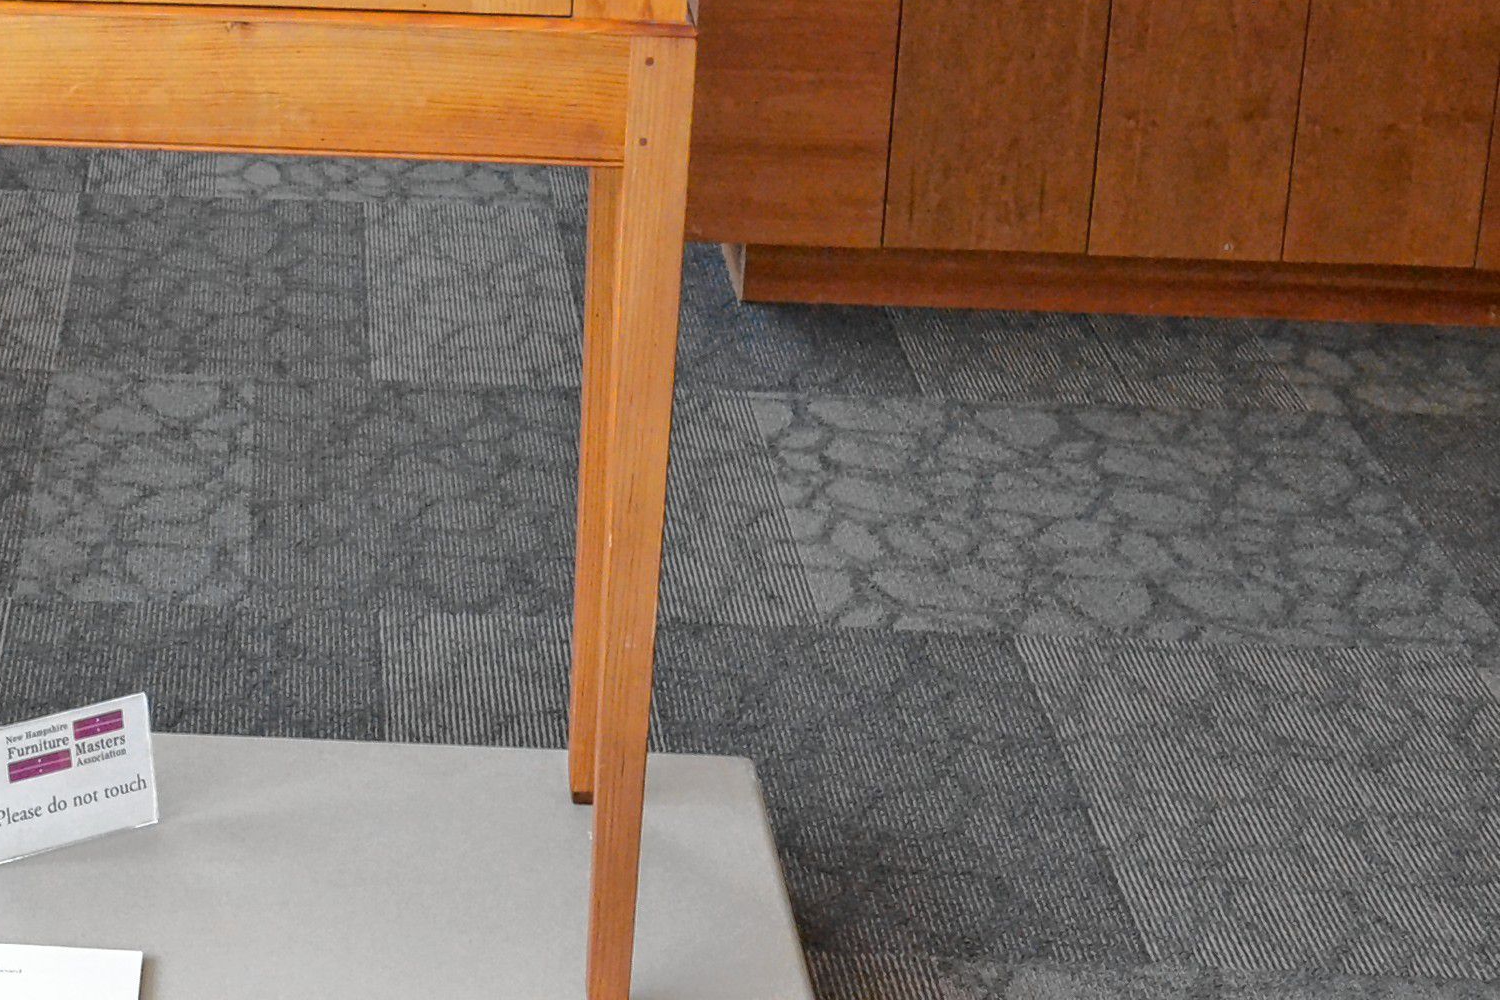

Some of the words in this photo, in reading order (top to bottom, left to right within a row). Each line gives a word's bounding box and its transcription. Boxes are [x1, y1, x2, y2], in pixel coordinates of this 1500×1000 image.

[5, 733, 24, 745] New
[25, 722, 68, 739] Hampshire
[7, 736, 70, 760] Furniture
[74, 734, 127, 757] Masters
[76, 747, 128, 768] Association
[46, 795, 68, 815] do
[72, 790, 100, 808] not
[103, 773, 148, 800] touch
